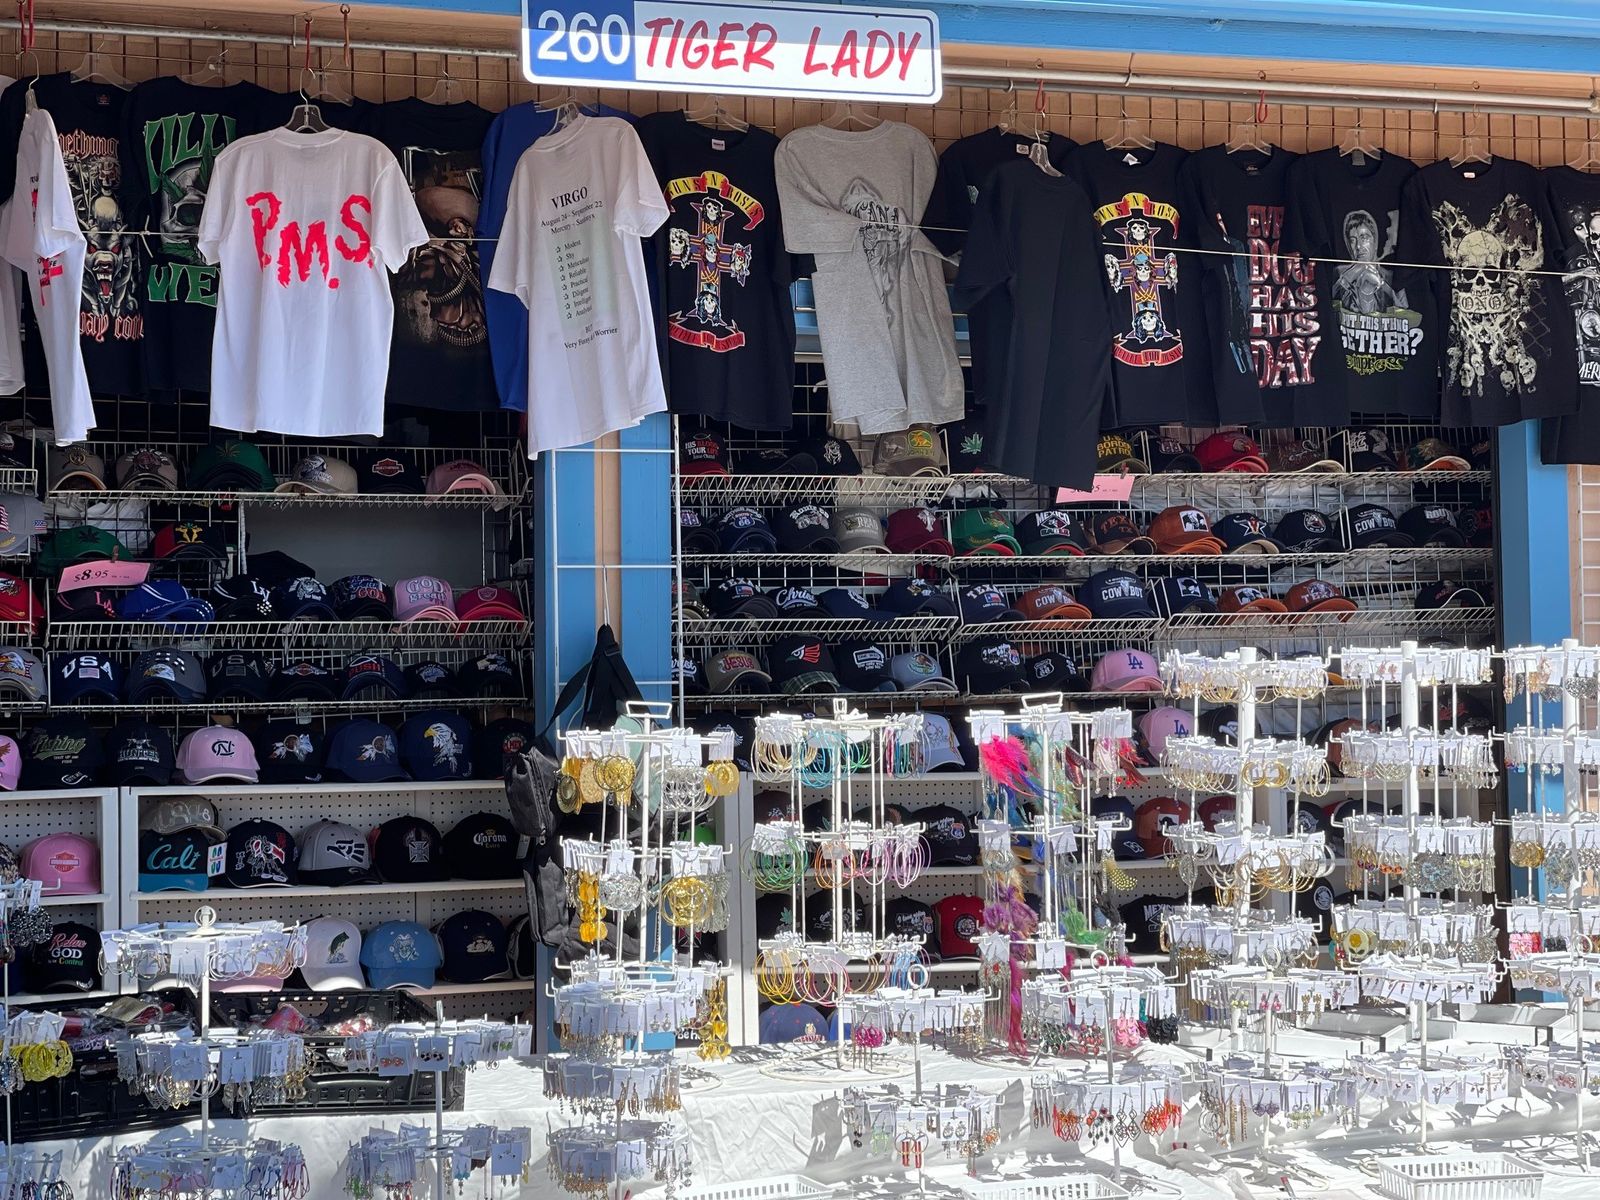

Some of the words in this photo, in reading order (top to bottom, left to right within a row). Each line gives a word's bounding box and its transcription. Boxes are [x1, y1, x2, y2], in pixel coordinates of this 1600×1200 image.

[537, 9, 631, 65] 260
[642, 16, 778, 73] TIGER
[802, 26, 922, 81] LADY
[551, 186, 588, 209] VIRGO
[540, 217, 561, 227] August
[571, 203, 594, 217] September
[594, 200, 603, 208] 22
[246, 191, 374, 289] P.M.S.
[565, 252, 575, 261] Shy
[1250, 284, 1318, 310] HAS
[1250, 310, 1321, 337] HIS
[1360, 315, 1379, 331] THIS
[564, 337, 577, 351] Very
[593, 326, 618, 338] Worrier
[1250, 335, 1322, 388] DAY
[687, 446, 706, 456] YOUR
[1034, 510, 1070, 527] MEXICO
[73, 569, 109, 583] $8.95
[406, 578, 444, 593] GOD
[61, 655, 114, 681] USA
[211, 654, 261, 679] USA
[1126, 652, 1144, 670] LA
[1174, 719, 1189, 738] LA
[33, 734, 87, 755] Fishing
[473, 832, 507, 847] Corona
[145, 843, 200, 870] Cali
[48, 932, 87, 952] Relax
[51, 947, 82, 959] GOD
[58, 956, 84, 966] Control
